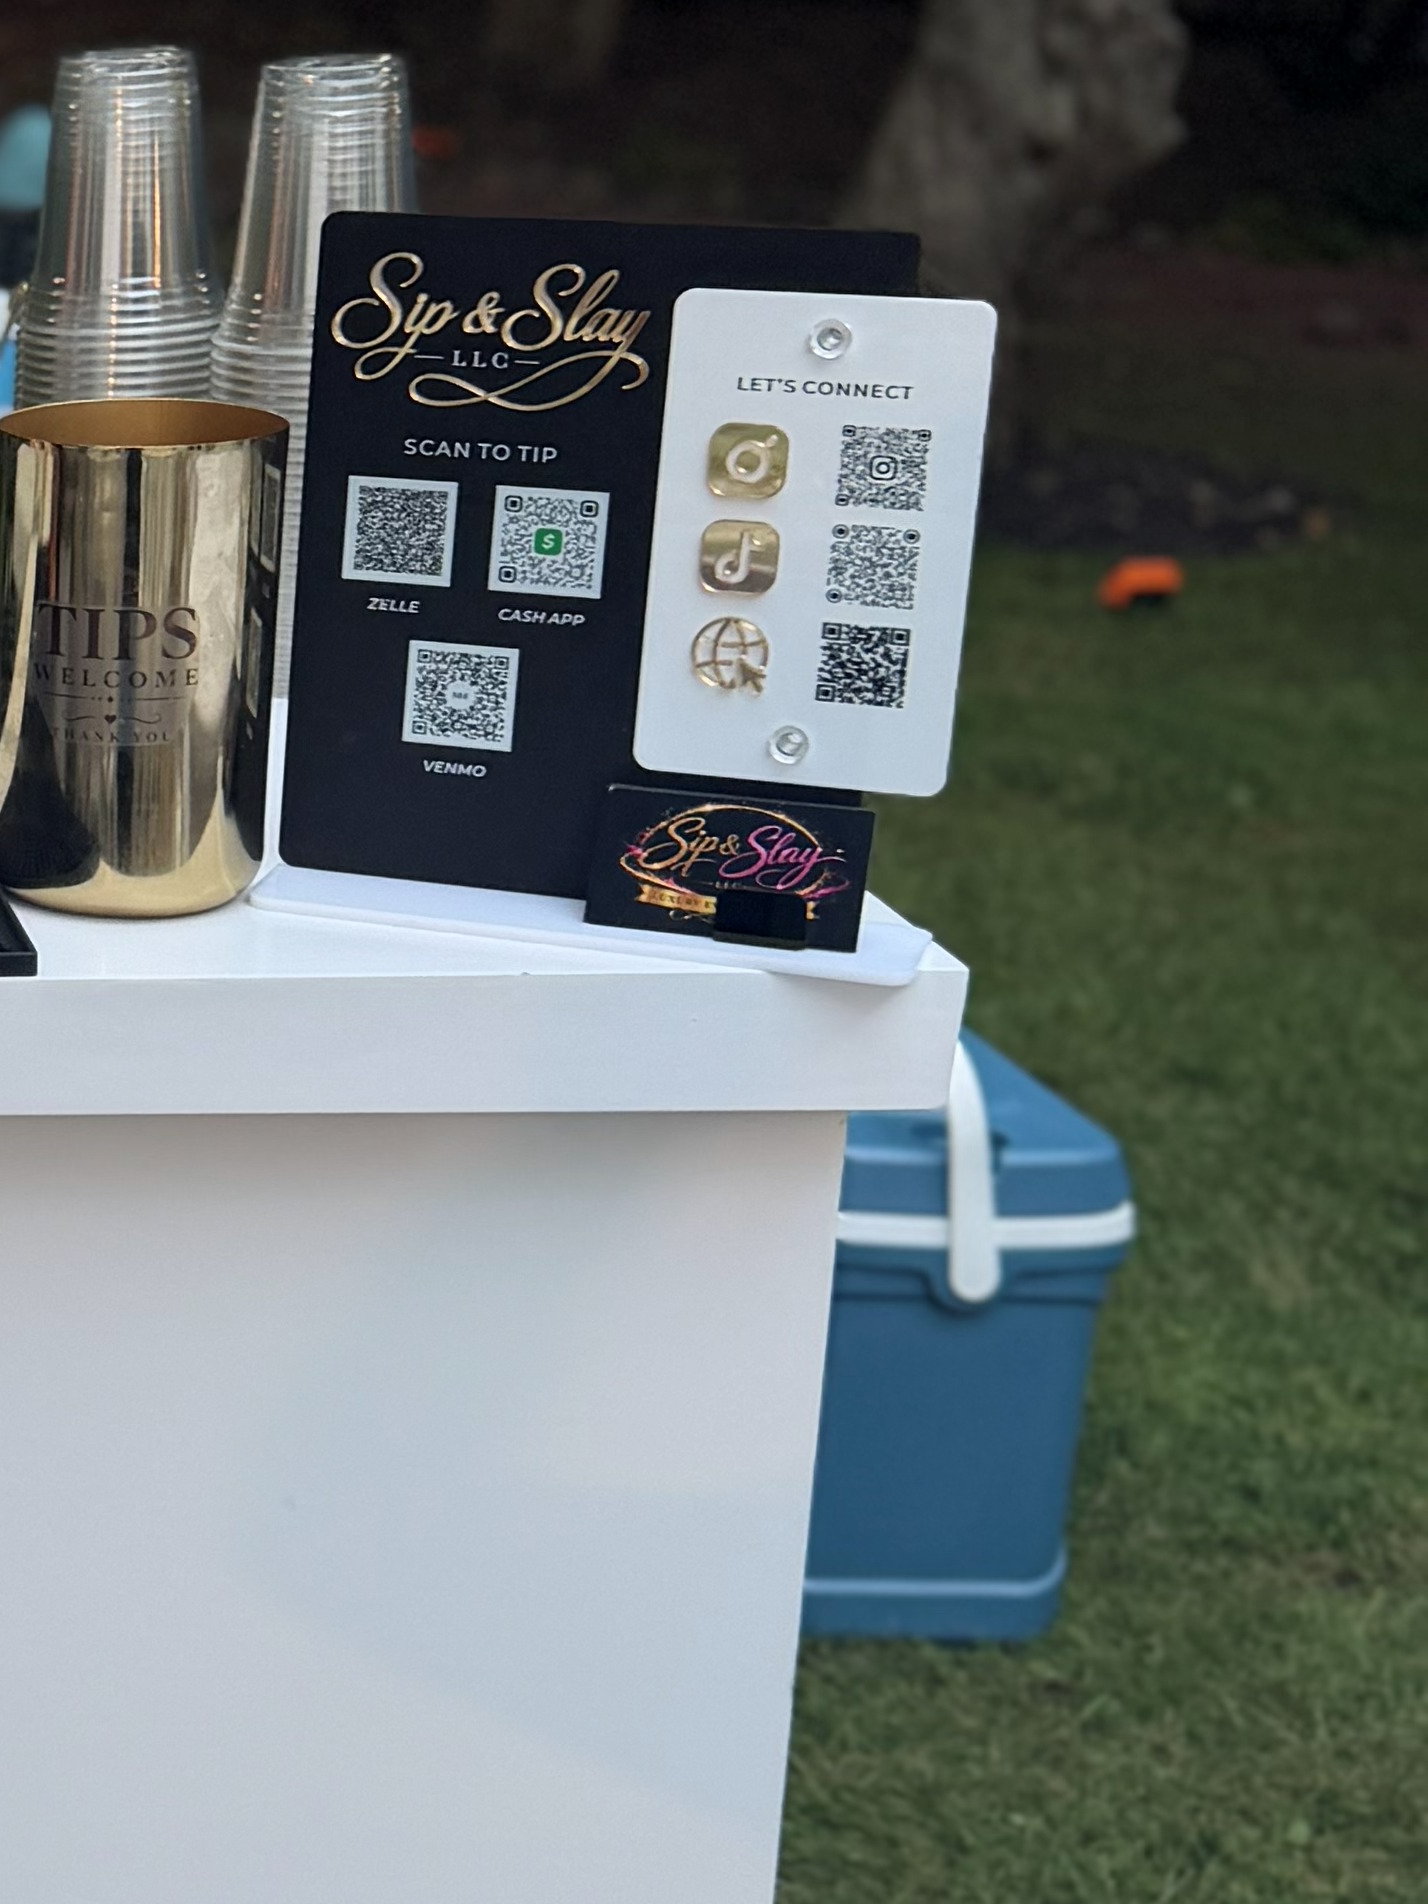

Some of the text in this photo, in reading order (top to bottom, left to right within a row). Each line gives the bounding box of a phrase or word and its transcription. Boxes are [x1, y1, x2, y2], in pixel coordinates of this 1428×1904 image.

[331, 252, 460, 380] Sip
[462, 291, 506, 334] &
[451, 349, 509, 369] LLC
[737, 376, 914, 399] LET'S CONNECT
[403, 438, 558, 463] SCAN TO TIP
[366, 597, 420, 614] ZELLE
[497, 608, 586, 626] CASH APP
[38, 603, 197, 661] TIPS
[33, 662, 199, 688] WELCOME
[422, 759, 487, 778] VENMO
[637, 816, 846, 890] Sip & Slay
